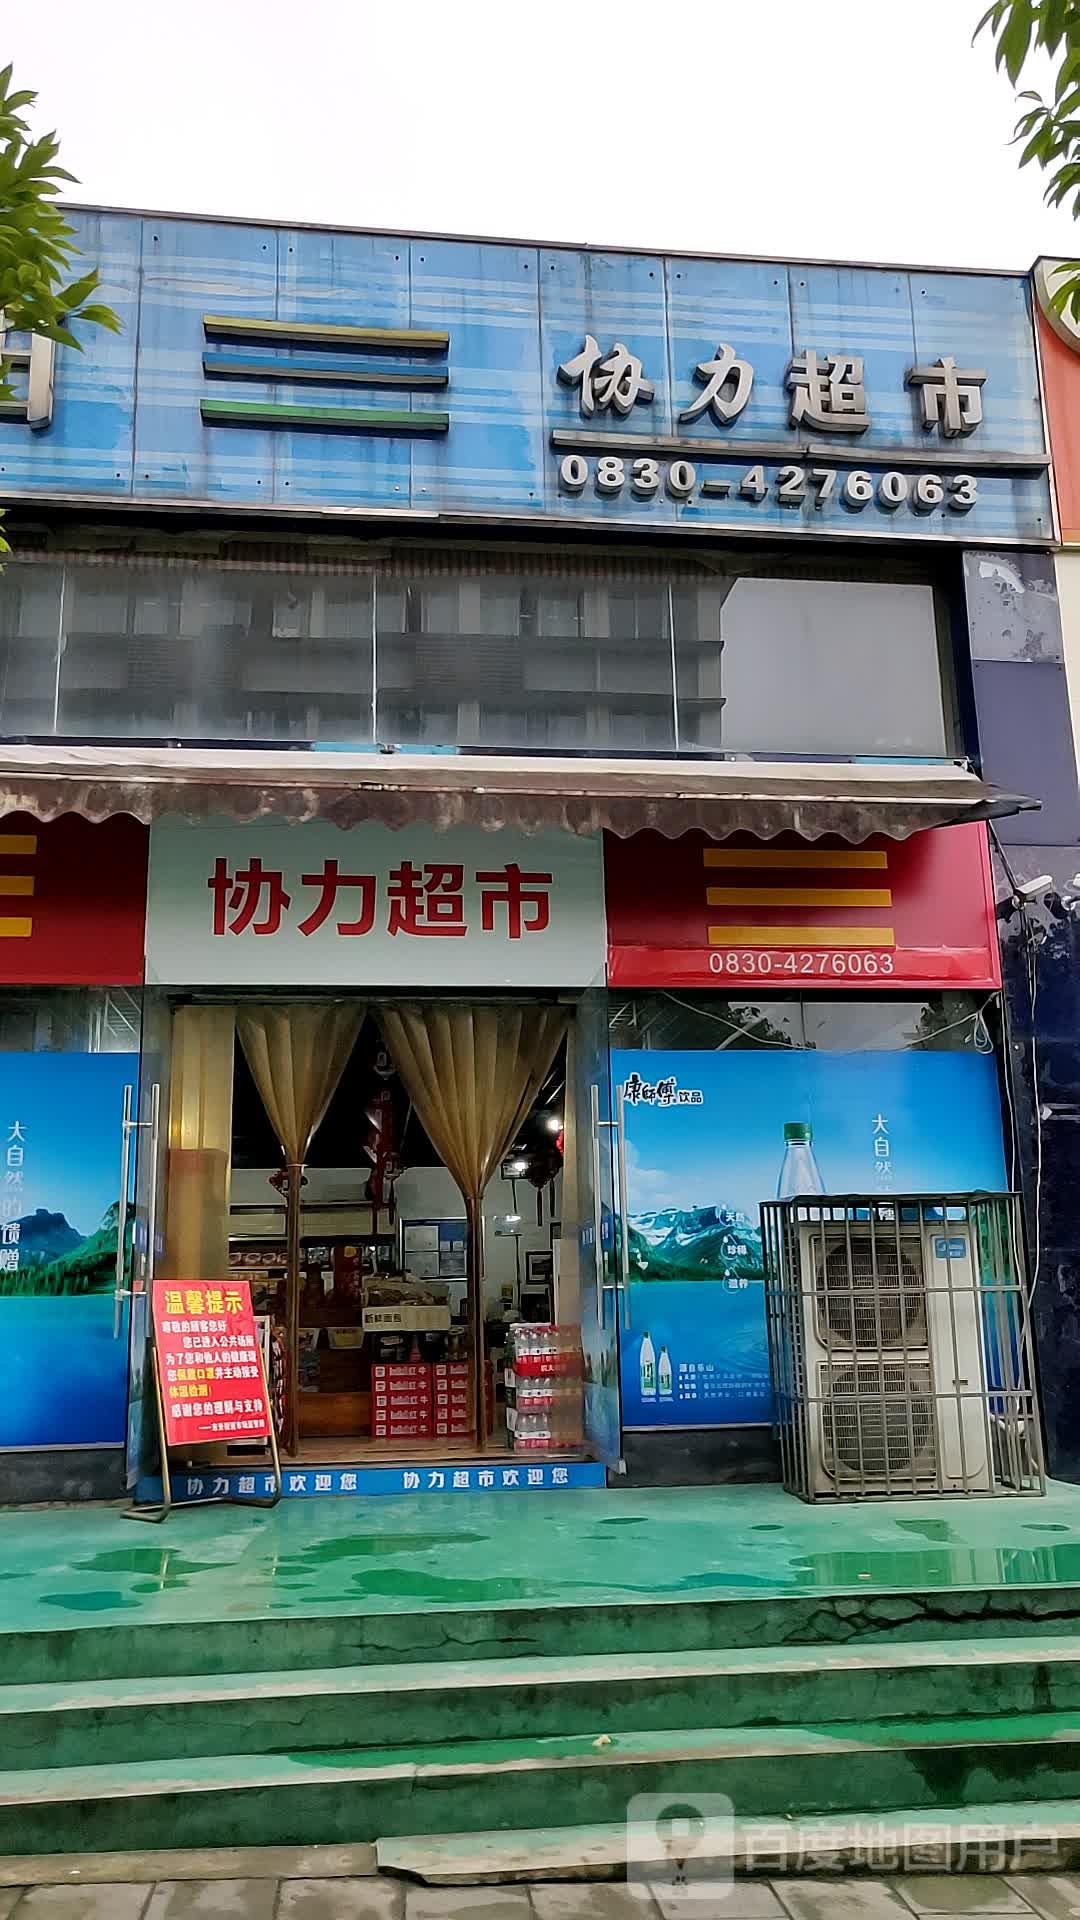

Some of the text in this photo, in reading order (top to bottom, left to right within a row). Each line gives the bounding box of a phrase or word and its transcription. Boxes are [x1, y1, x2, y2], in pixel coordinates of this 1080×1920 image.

[559, 335, 987, 438] 协力超市
[559, 454, 978, 511] 0830-4276063
[207, 857, 553, 939] 协力超市
[709, 952, 894, 975] 0830-4276063
[165, 1290, 243, 1314] 温馨提示
[403, 1467, 568, 1488] 协力超市欢迎您
